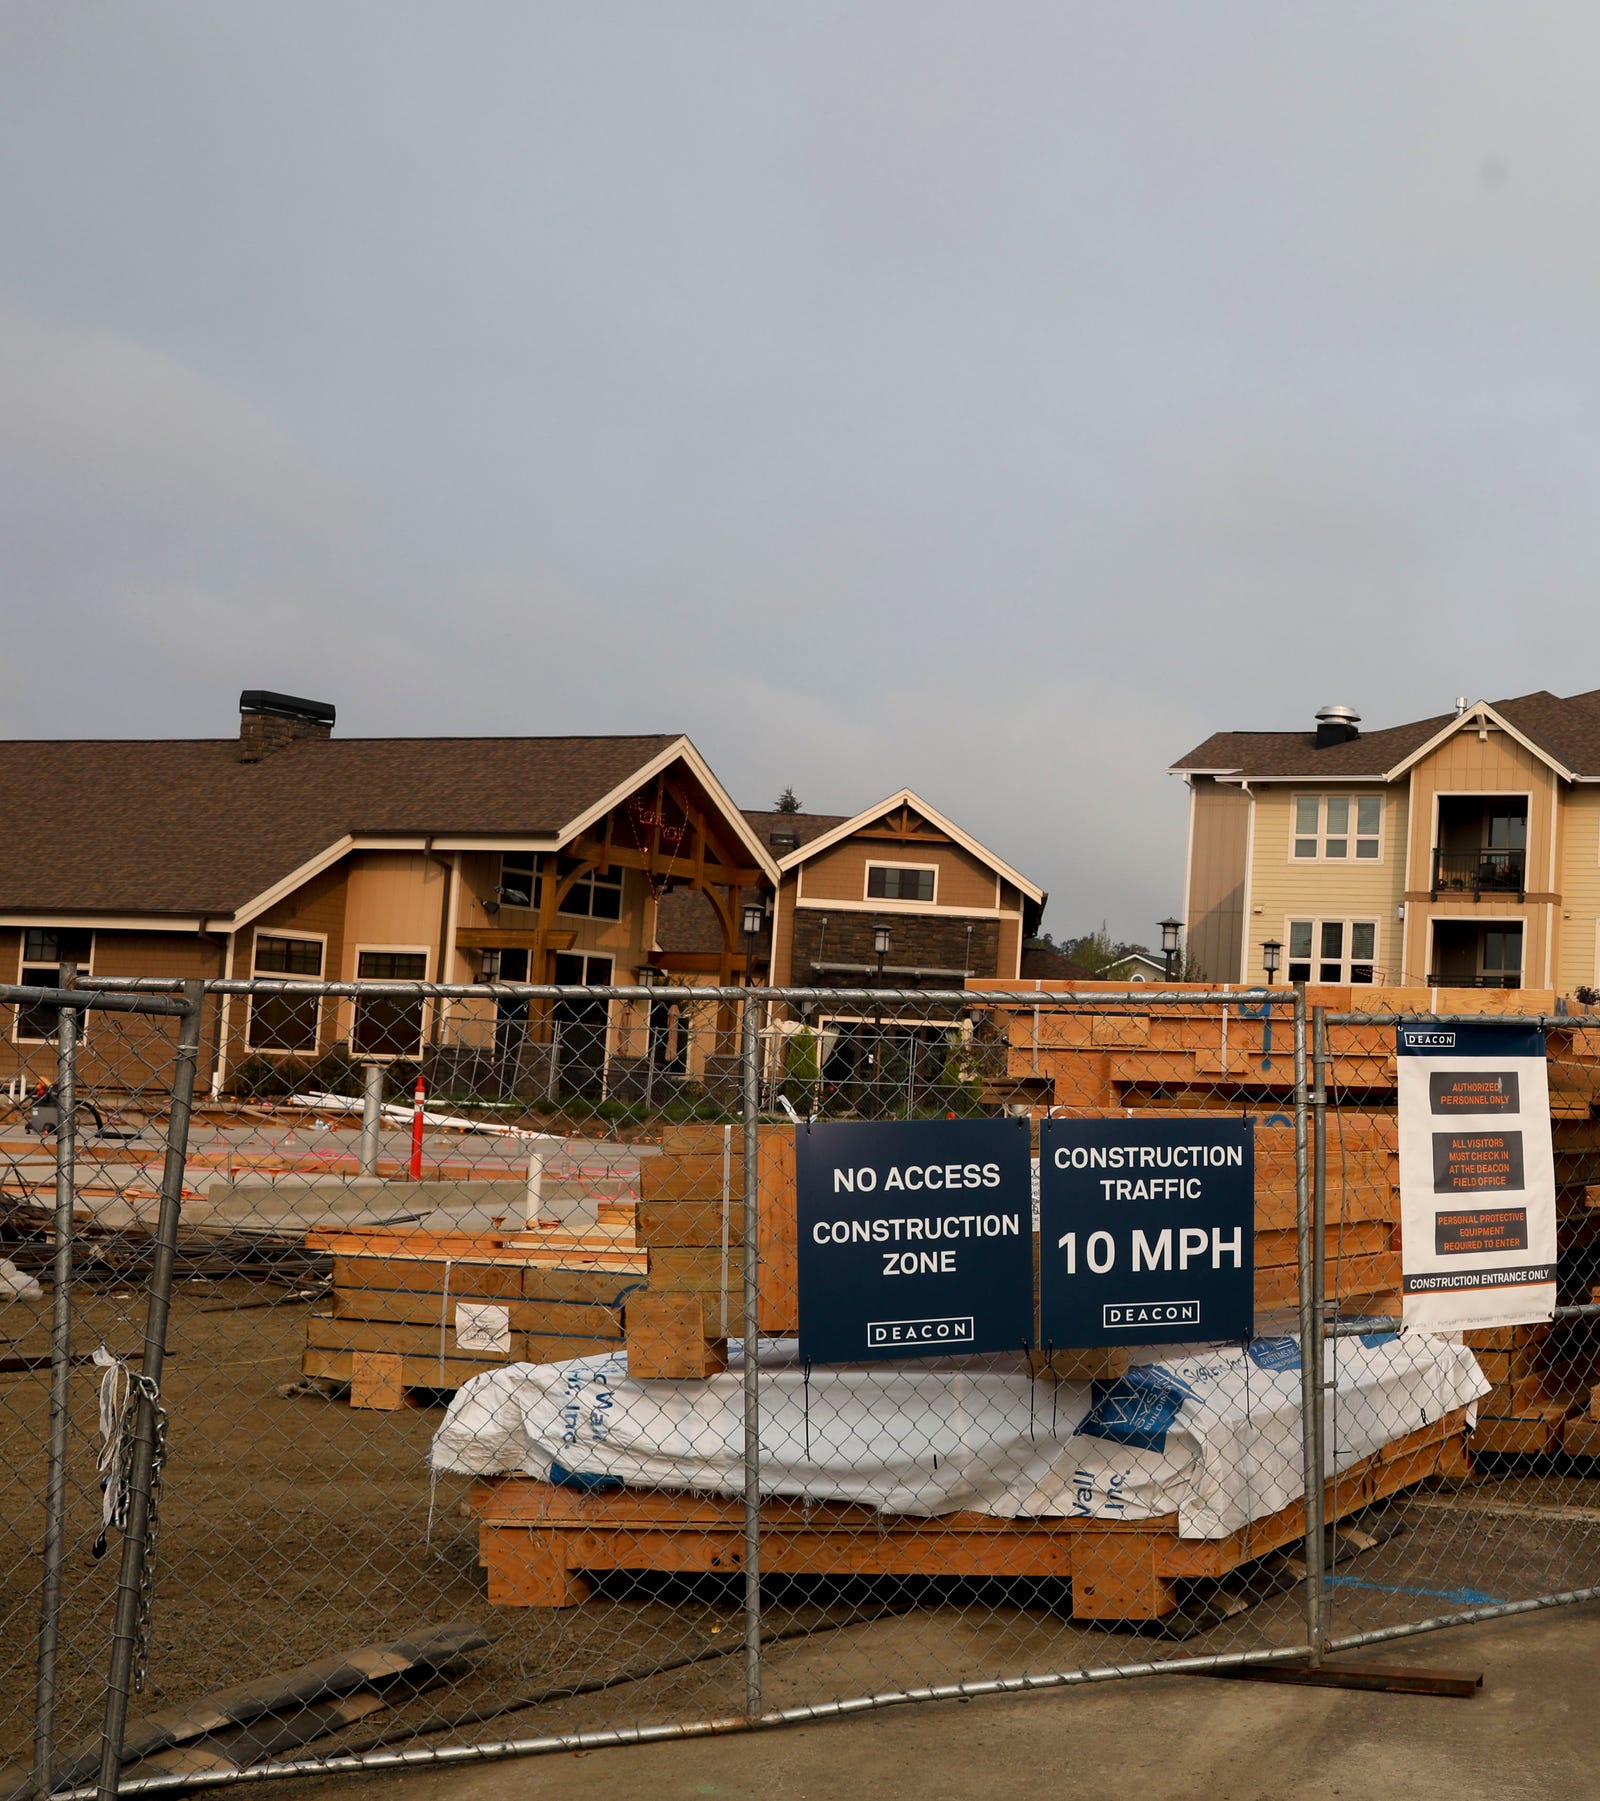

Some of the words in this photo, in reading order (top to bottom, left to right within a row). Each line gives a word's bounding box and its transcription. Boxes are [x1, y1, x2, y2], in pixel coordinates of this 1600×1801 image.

[1409, 1035, 1453, 1044] DEACON
[1452, 1082, 1500, 1092] AUTHORIZED
[1440, 1096, 1488, 1104] PERSONNEL
[1490, 1095, 1509, 1104] ONLY
[1452, 1139, 1466, 1148] ALL
[1468, 1139, 1504, 1148] VISITORS
[1054, 1146, 1243, 1169] CONSTRUCTION
[1449, 1152, 1469, 1161] MUST
[1471, 1151, 1499, 1160] CHECK
[1501, 1151, 1509, 1159] IN
[1449, 1165, 1459, 1174] AT
[1461, 1164, 1474, 1173] THE
[1476, 1163, 1509, 1173] DEACON
[833, 1167, 877, 1193] NO
[884, 1163, 1000, 1191] ACCESS
[1453, 1177, 1476, 1187] FIELD
[1478, 1176, 1506, 1186] OFFICE
[1100, 1178, 1201, 1200] TRAFFIC
[1438, 1215, 1478, 1225] PERSONAL
[1480, 1212, 1524, 1224] PROTECTIVE
[813, 1214, 1019, 1244] CONSTRUCTION
[1460, 1226, 1505, 1237] EQUIPMENT
[1058, 1230, 1115, 1274] 10
[1132, 1226, 1242, 1272] MPH
[1444, 1241, 1482, 1251] REQUIRED
[1484, 1240, 1494, 1249] TO
[1495, 1238, 1520, 1248] ENTER
[882, 1250, 957, 1275] ZONE
[1410, 1275, 1480, 1290] CONSTRUCTION
[1481, 1271, 1527, 1285] ENTRANCE
[1528, 1269, 1549, 1280] ONLY
[1111, 1306, 1192, 1322] DEACON
[875, 1323, 966, 1341] DEACON
